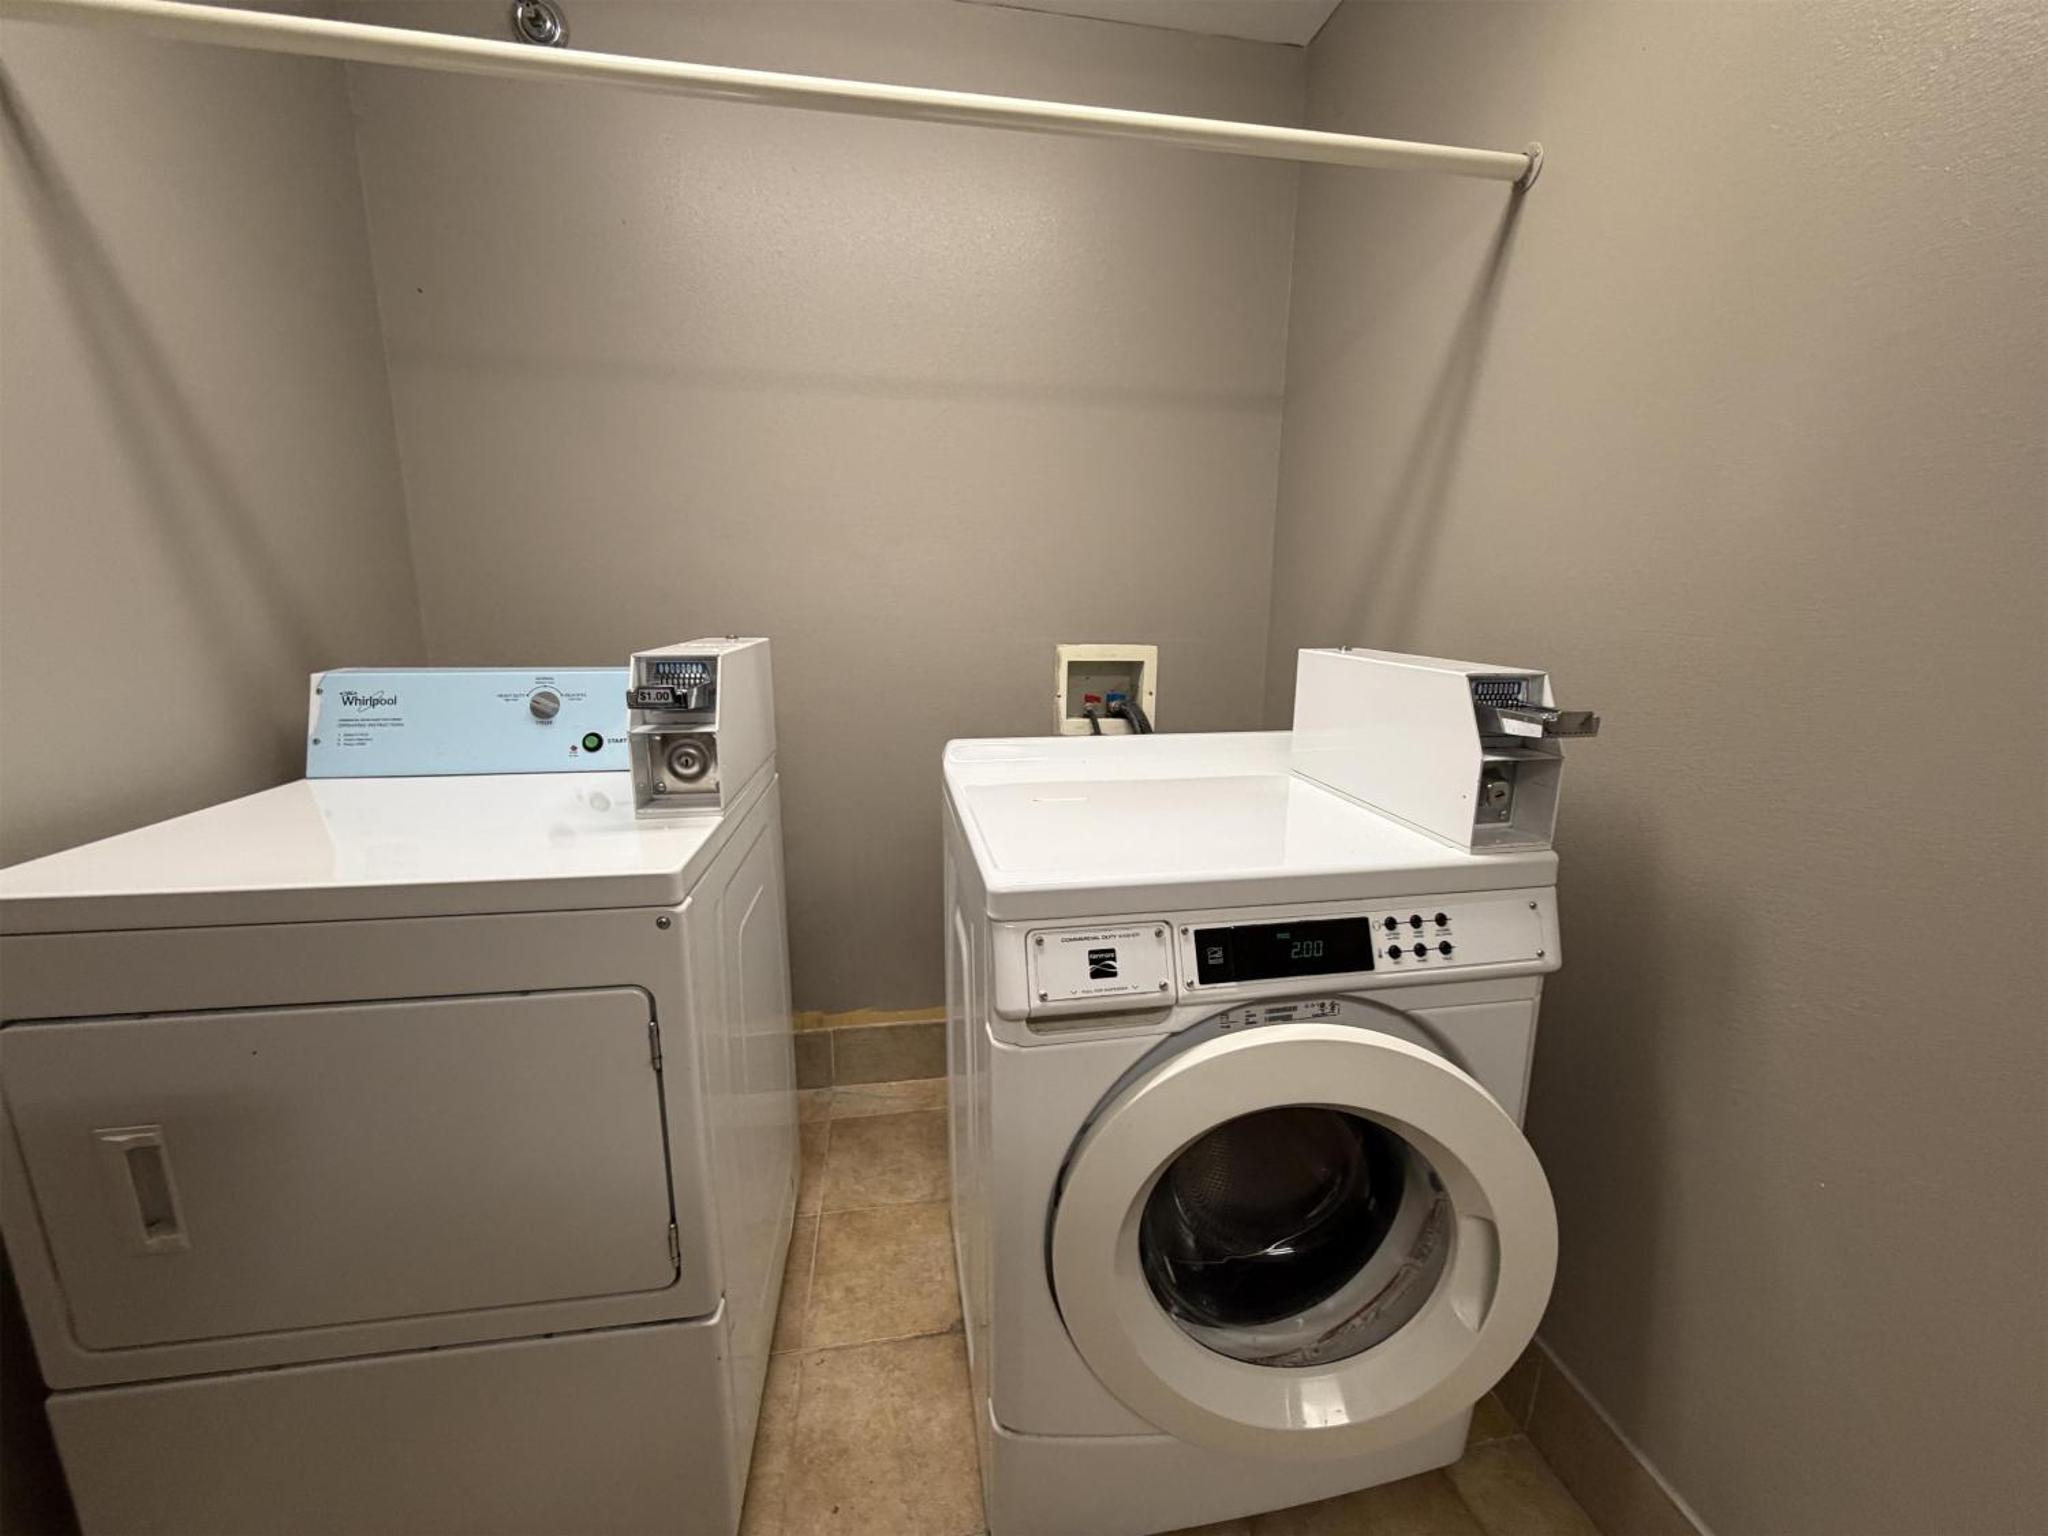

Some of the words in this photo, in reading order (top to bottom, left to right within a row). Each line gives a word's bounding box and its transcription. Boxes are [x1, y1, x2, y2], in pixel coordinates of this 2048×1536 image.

[341, 695, 397, 709] Whirlpool
[639, 690, 670, 701] $1.00
[1290, 940, 1323, 959] 2.00
